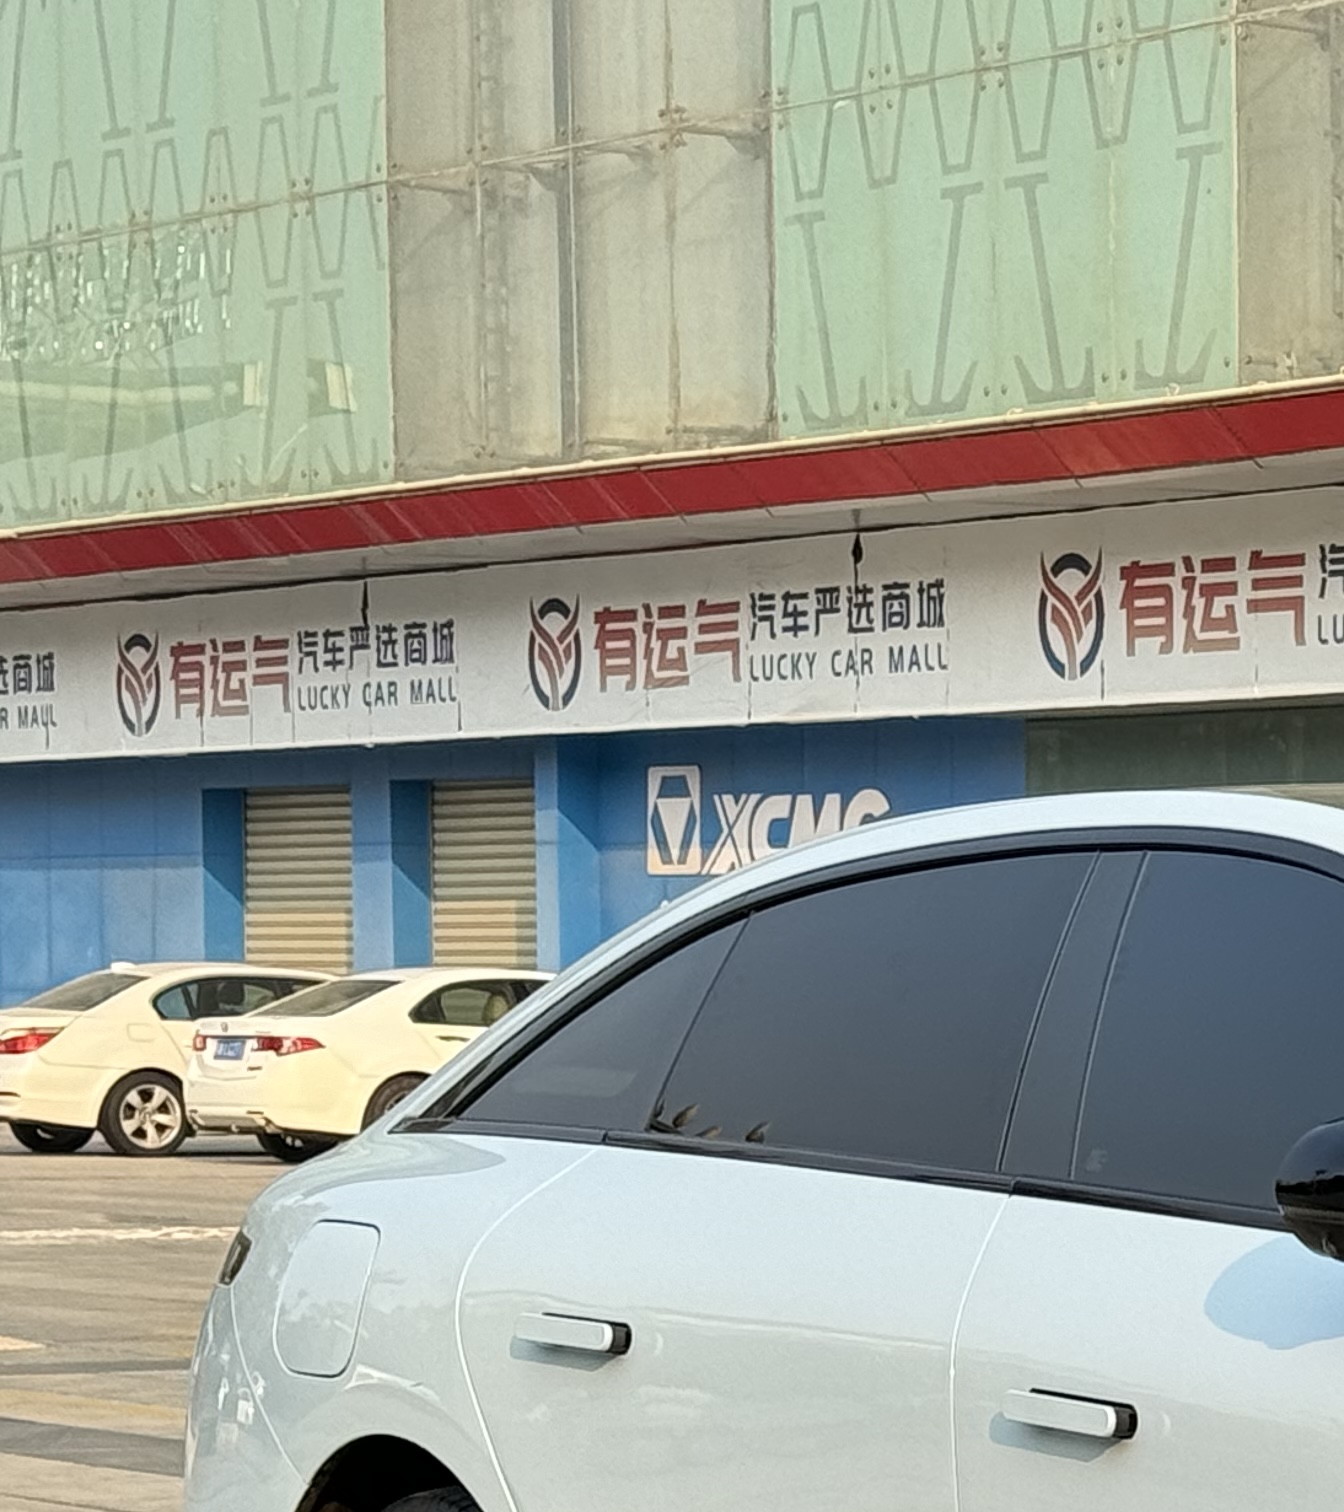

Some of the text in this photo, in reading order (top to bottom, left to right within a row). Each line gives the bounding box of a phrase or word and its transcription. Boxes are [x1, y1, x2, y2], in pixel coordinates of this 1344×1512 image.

[749, 578, 945, 641] 汽车严选商城
[1119, 549, 1306, 657] 有运气
[169, 635, 292, 719] 有运气
[297, 618, 456, 674] 汽车严选商城
[593, 599, 742, 692] 有运气
[750, 642, 948, 683] LUCKY CAR MALL
[298, 676, 457, 712] LUCKY CAR MALL
